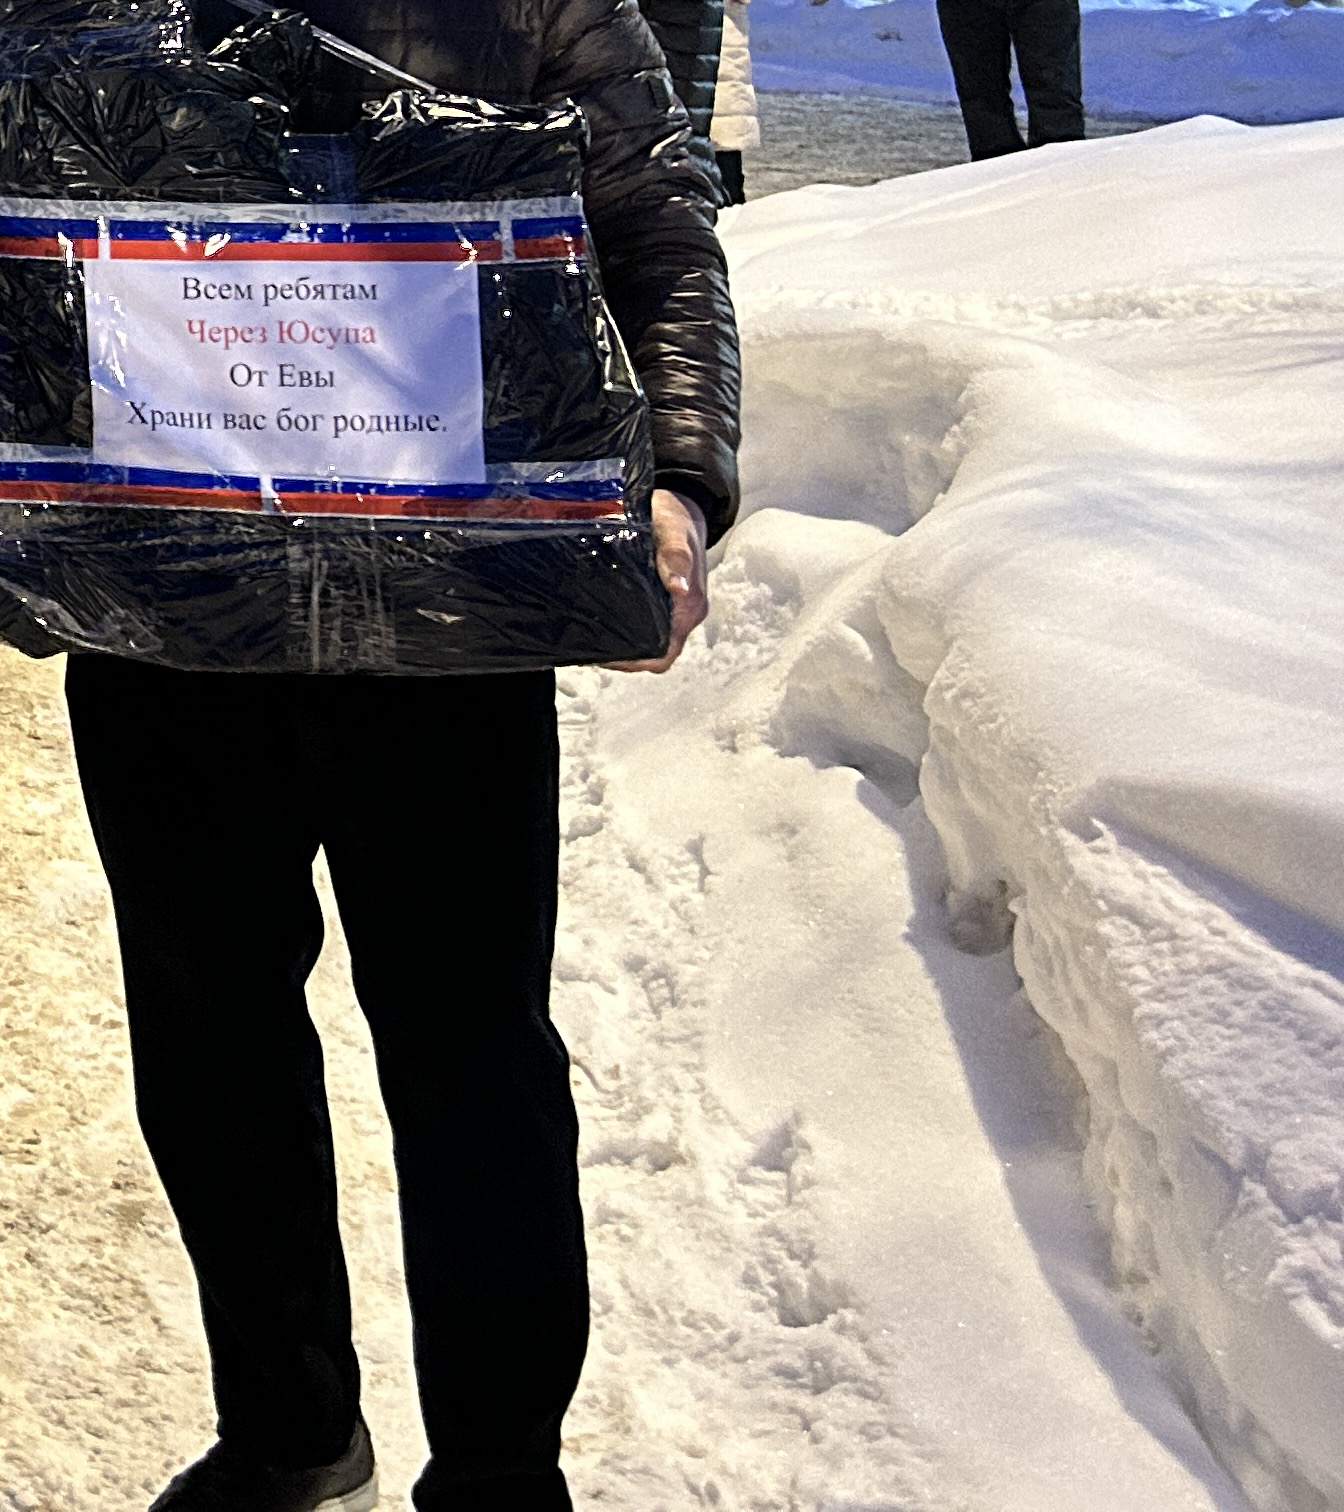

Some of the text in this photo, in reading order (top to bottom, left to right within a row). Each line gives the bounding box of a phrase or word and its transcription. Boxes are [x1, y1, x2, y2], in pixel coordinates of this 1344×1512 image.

[181, 276, 378, 307] Всем ребятам
[185, 318, 377, 350] Через Юсупа
[229, 361, 336, 388] От Евы
[125, 400, 448, 439] Храни вас бог родные.
